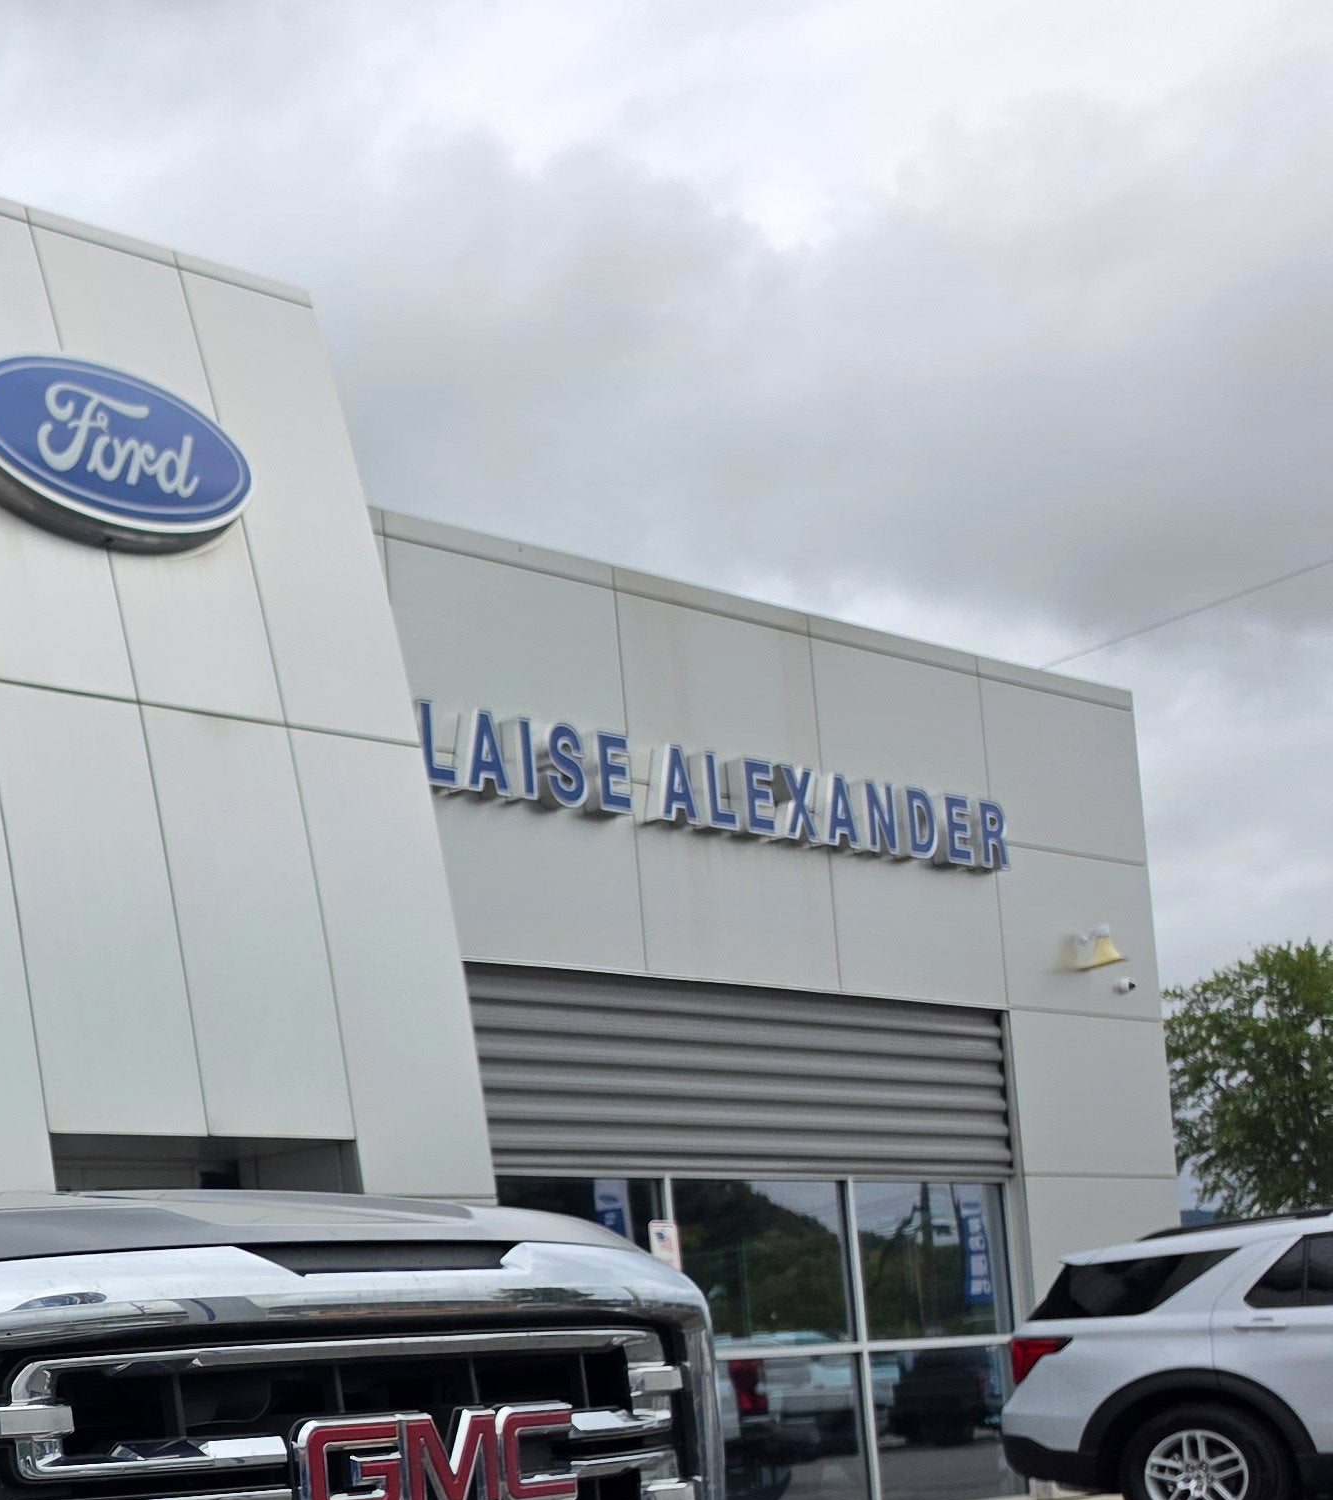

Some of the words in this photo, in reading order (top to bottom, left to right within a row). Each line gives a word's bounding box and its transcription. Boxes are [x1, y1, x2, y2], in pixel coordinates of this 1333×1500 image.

[37, 381, 198, 498] Ford
[417, 699, 632, 815] LAISE
[661, 744, 1012, 871] ALEXANDER
